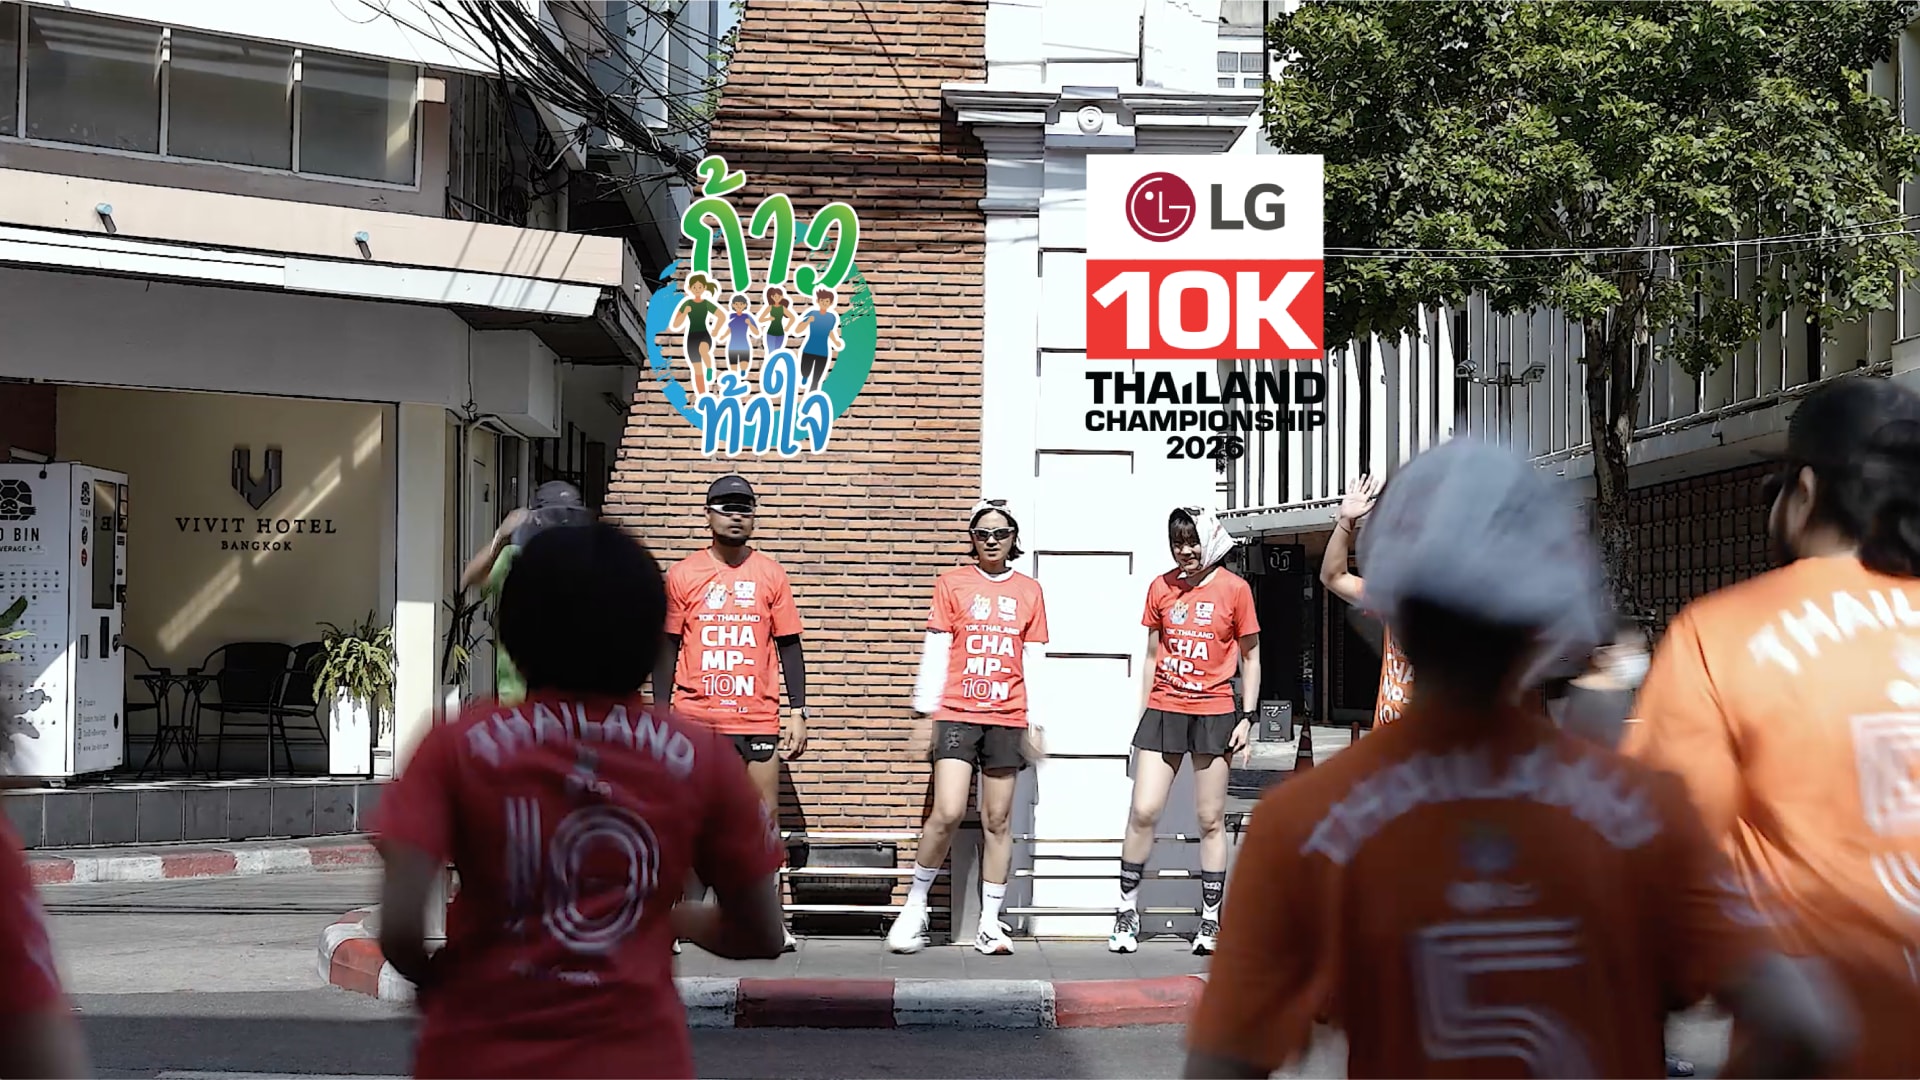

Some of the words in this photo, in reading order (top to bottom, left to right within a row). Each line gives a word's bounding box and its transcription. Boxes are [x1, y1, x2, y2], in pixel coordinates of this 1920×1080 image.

[14, 527, 39, 541] BIN
[175, 517, 245, 533] VIVIT
[257, 518, 337, 534] HOTEL
[221, 540, 292, 551] BANGKOK
[717, 614, 761, 622] THAILAND
[701, 625, 757, 648] CHA
[1178, 629, 1215, 640] THAILAND
[965, 634, 1015, 657] CHA
[1168, 638, 1209, 660] CHA
[701, 650, 755, 671] MP-
[963, 656, 1012, 677] MP-
[466, 701, 694, 775] THAILAND
[506, 797, 661, 953] 10
